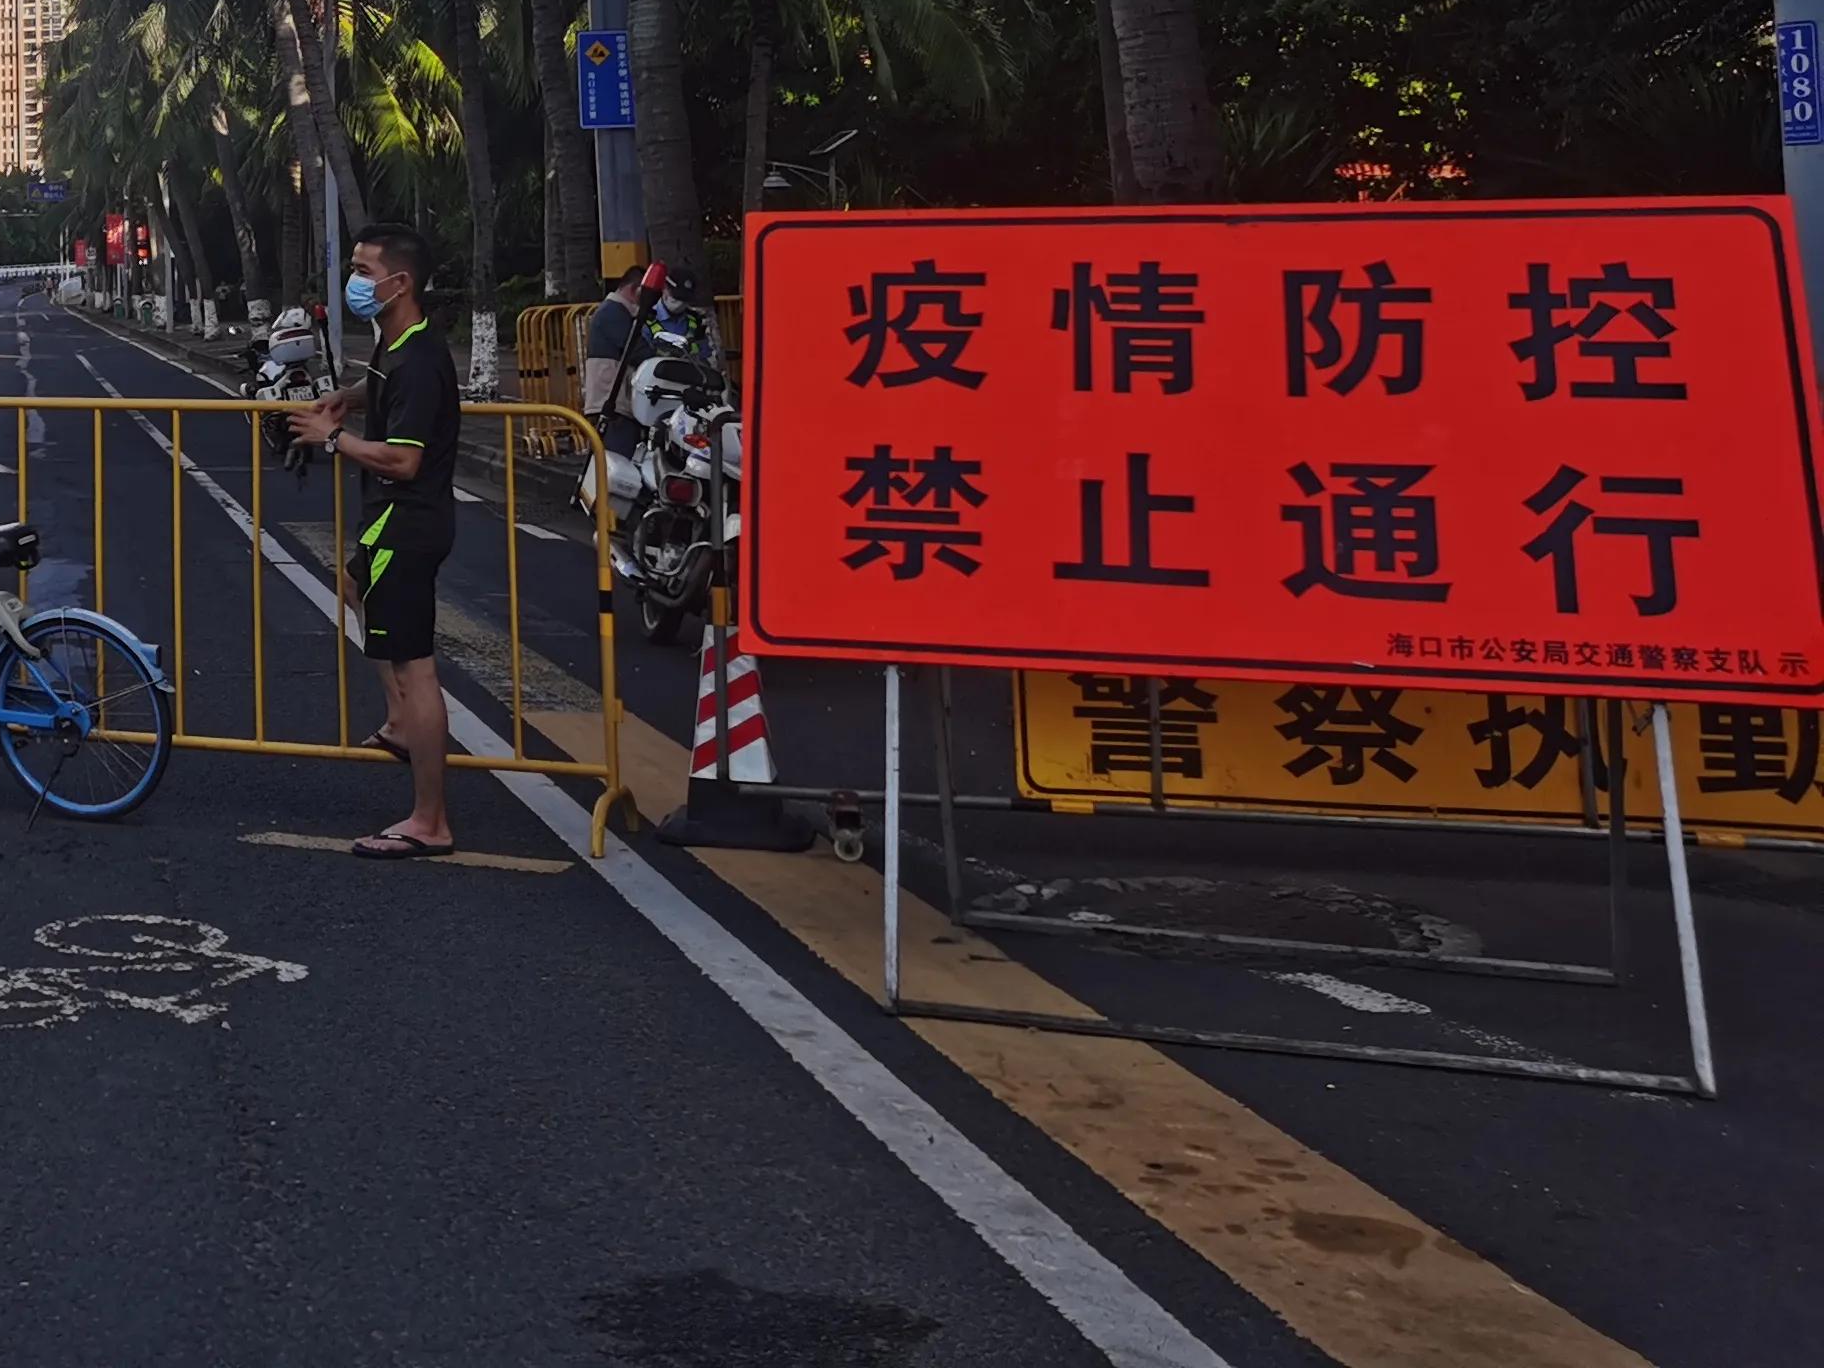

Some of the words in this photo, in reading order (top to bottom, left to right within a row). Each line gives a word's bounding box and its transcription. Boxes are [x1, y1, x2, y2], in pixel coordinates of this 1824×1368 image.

[1791, 29, 1813, 122] 1080
[844, 259, 1689, 401] 疫情防控
[842, 444, 1701, 617] 禁止通行
[1386, 632, 1768, 677] 海口市公安局交通警察支队
[1778, 651, 1811, 678] 示
